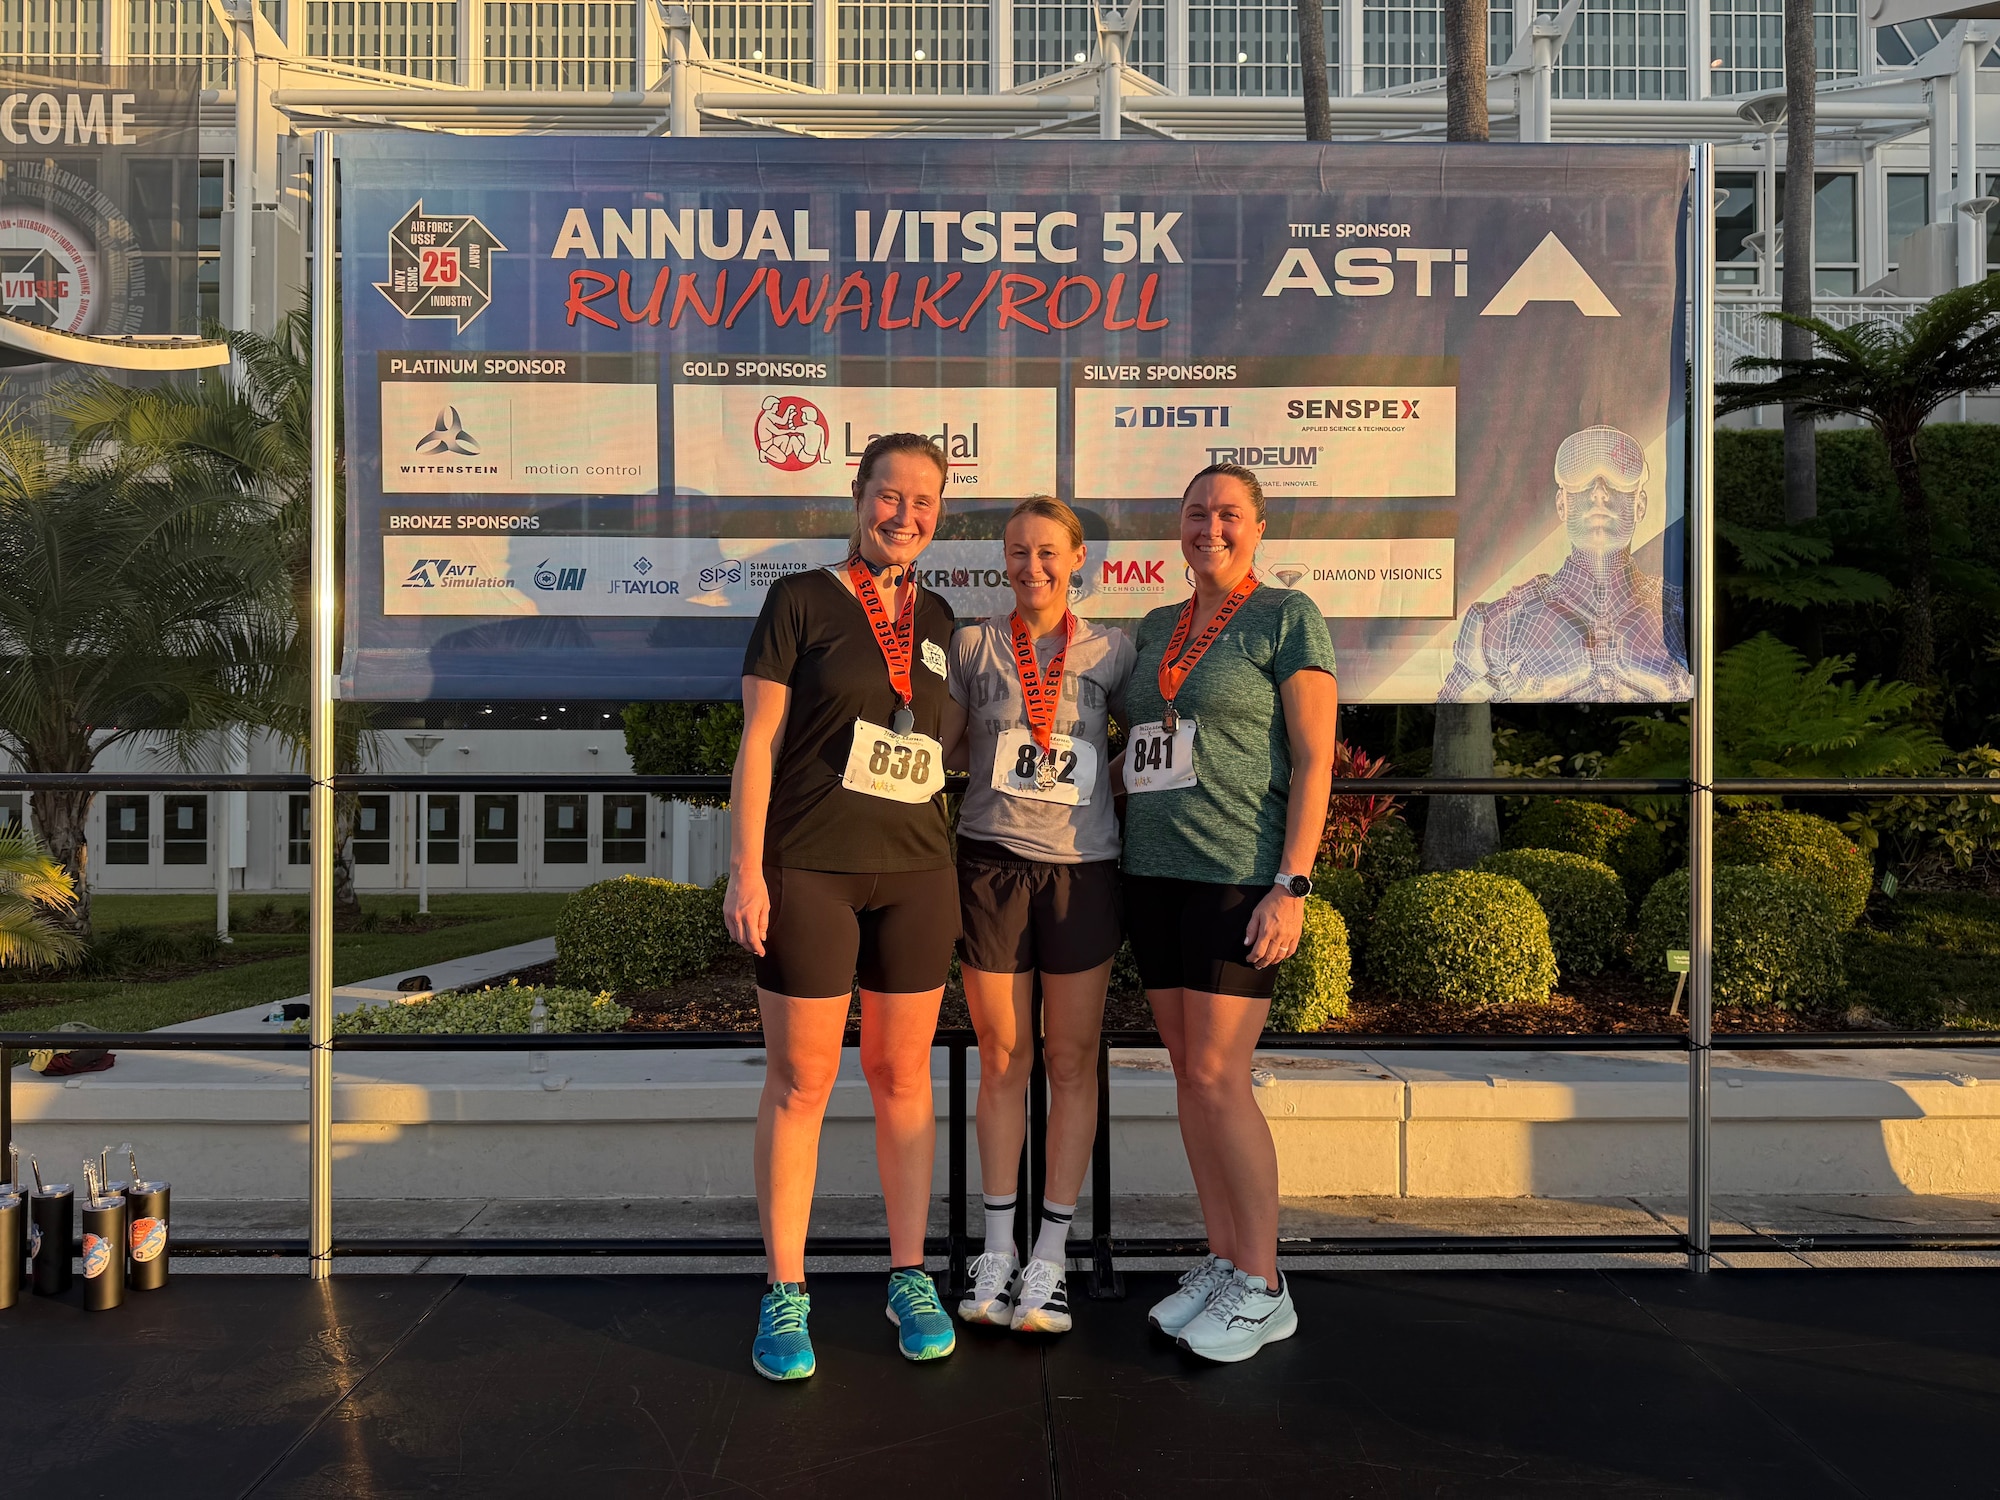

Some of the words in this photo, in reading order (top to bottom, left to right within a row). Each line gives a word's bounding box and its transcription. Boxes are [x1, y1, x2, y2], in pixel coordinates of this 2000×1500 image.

[1, 93, 137, 145] COME
[411, 221, 426, 232] AIR
[427, 221, 453, 233] FORCE
[551, 208, 829, 261] ANNUAL
[855, 209, 1077, 263] I/ITSEC
[1103, 211, 1184, 264] 5K
[1289, 223, 1330, 238] TITLE
[1335, 223, 1411, 238] SPONSOR
[411, 234, 436, 245] USSF
[469, 243, 480, 269] ARMY
[422, 251, 457, 283] 25
[1262, 247, 1468, 297] ASTi
[6, 280, 69, 298] I/ITSEC
[394, 270, 406, 293] NAVY
[407, 266, 418, 293] USMC
[430, 296, 472, 307] INDUSTRY
[390, 359, 478, 374] PLATINUM
[484, 359, 566, 375] SPONSOR
[682, 361, 729, 377] GOLD
[735, 361, 827, 379] SPONSORS
[1084, 365, 1140, 380] SILVER
[1147, 365, 1237, 380] SPONSORS
[1287, 399, 1420, 419] SENSPEX
[400, 465, 498, 474] WITTENSTEIN
[525, 463, 579, 475] motion
[585, 464, 642, 477] control
[953, 472, 978, 484] lives
[390, 515, 451, 529] BRONZE
[457, 516, 540, 529] SPONSORS
[447, 565, 477, 576] AVT
[556, 568, 587, 591] IAI
[700, 568, 741, 583] SPS
[1103, 561, 1164, 583] MAK
[1313, 569, 1376, 581] DIAMOND
[1380, 568, 1442, 580] VISIONICS
[441, 577, 515, 588] Simulation
[859, 580, 883, 615] 2025
[1178, 626, 1219, 672] I/ITSEC
[1216, 592, 1245, 622] 2025
[875, 621, 906, 676] I/ITSEC
[1016, 632, 1033, 666] 2025
[1023, 671, 1046, 727] I/ITSEC
[869, 740, 931, 784] 838
[1134, 735, 1173, 773] 841
